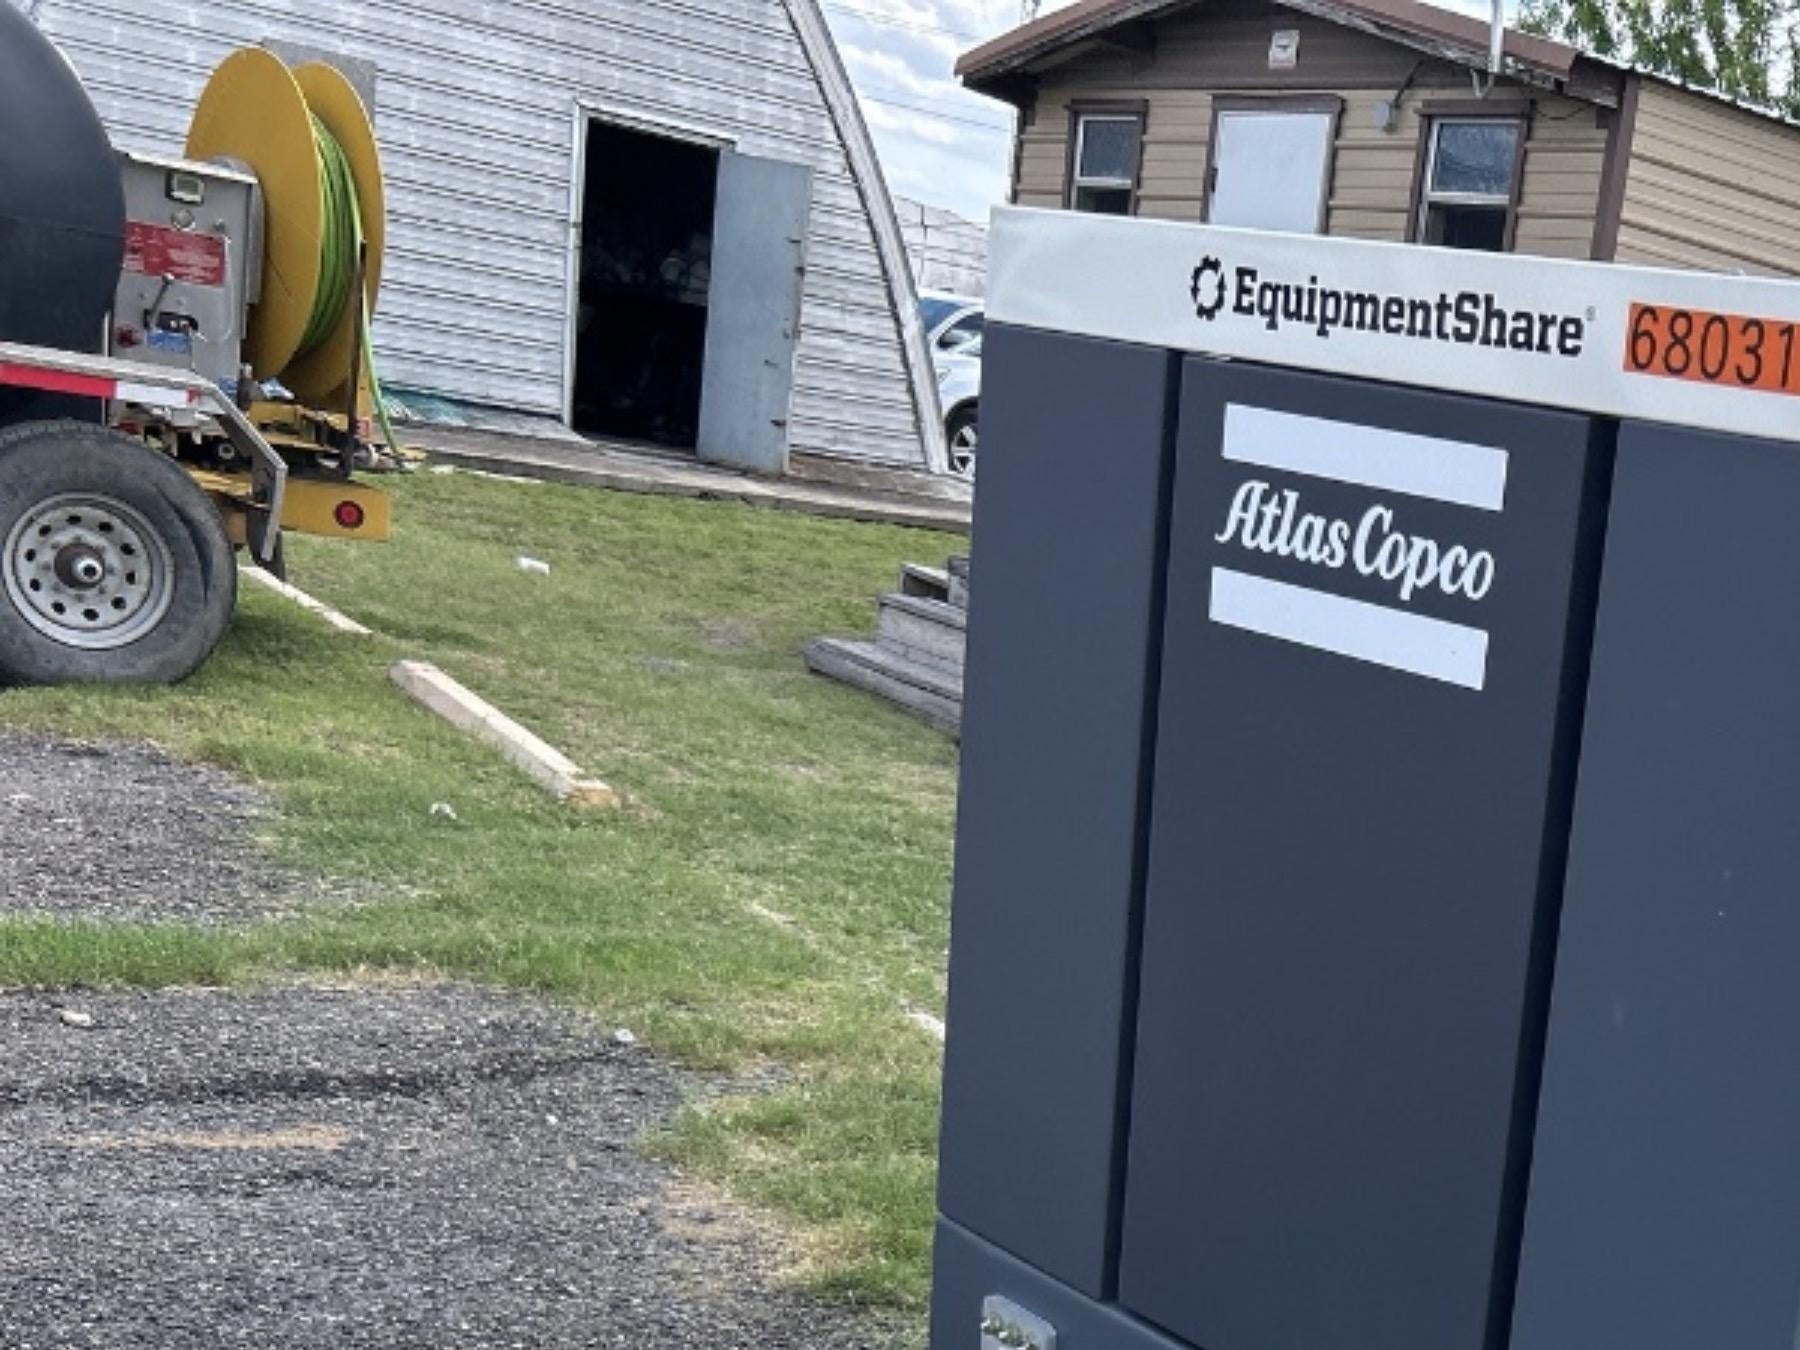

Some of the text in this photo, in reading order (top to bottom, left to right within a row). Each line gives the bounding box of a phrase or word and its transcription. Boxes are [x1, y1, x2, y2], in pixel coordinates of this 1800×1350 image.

[1232, 268, 1586, 358] EquipmentShare
[1214, 479, 1496, 601] Atlas Copco
